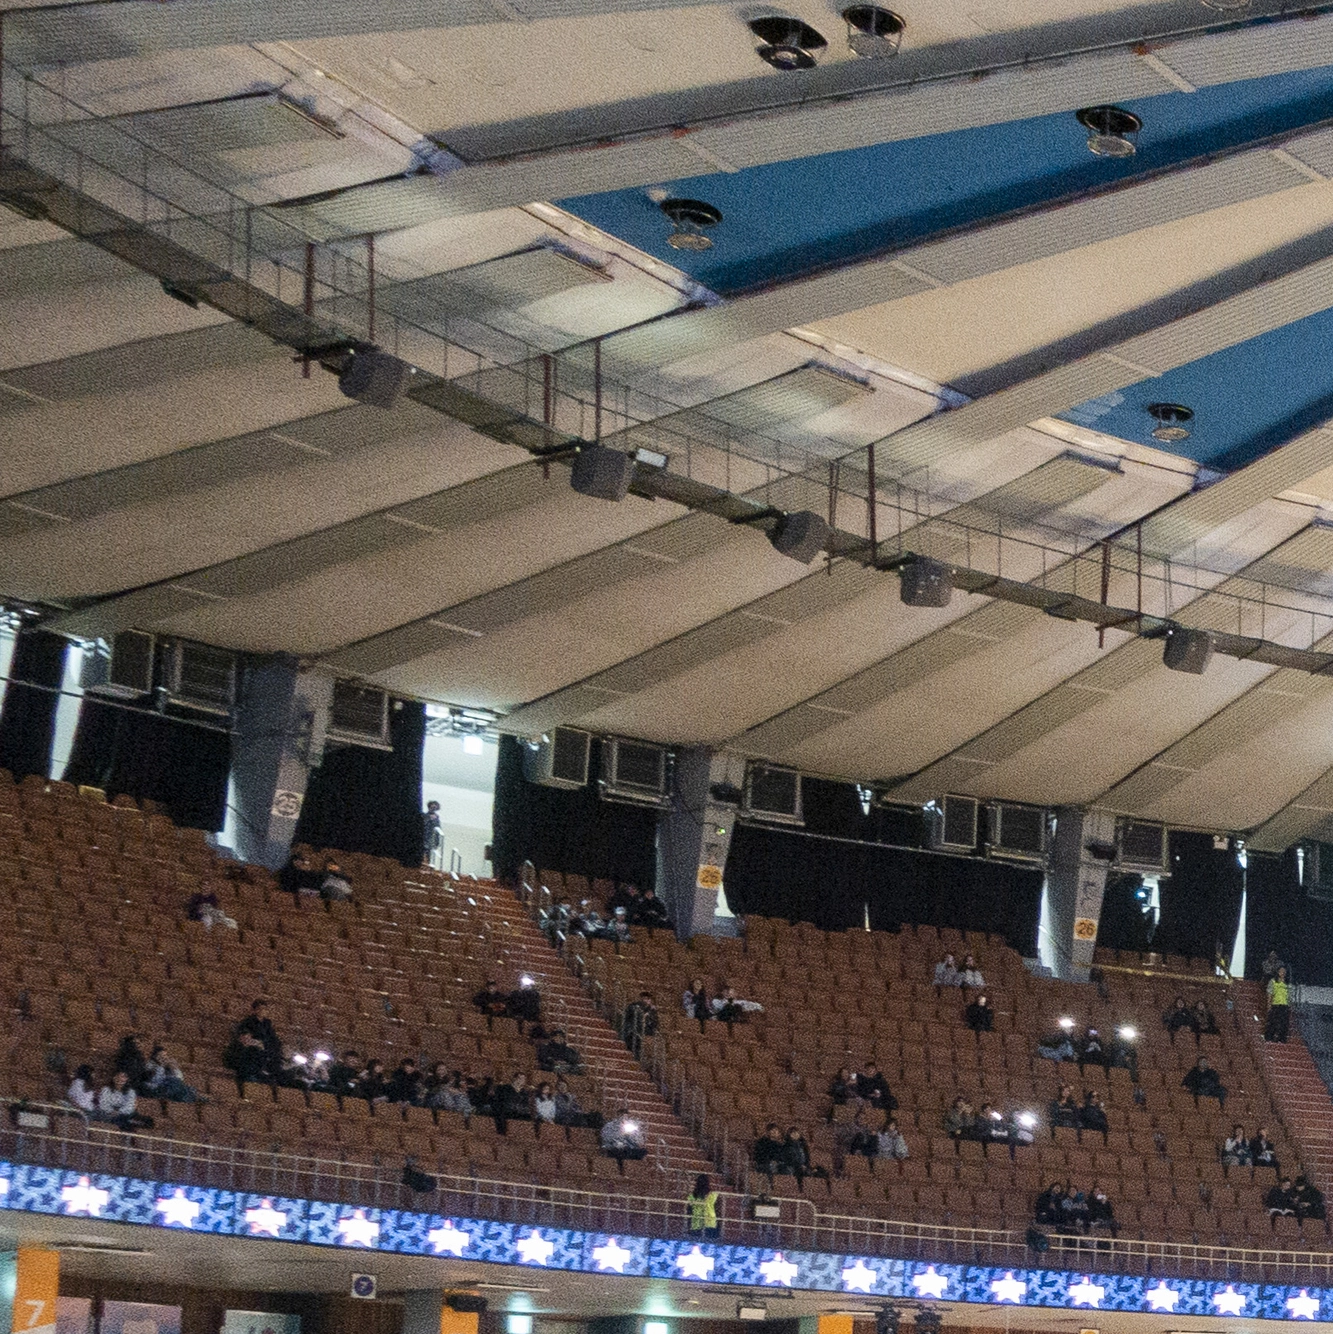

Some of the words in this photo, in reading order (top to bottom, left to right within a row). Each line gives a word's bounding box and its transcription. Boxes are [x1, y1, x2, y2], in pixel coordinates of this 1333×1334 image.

[277, 795, 297, 813] 25
[1078, 922, 1094, 935] 26
[25, 1300, 46, 1327] 7
